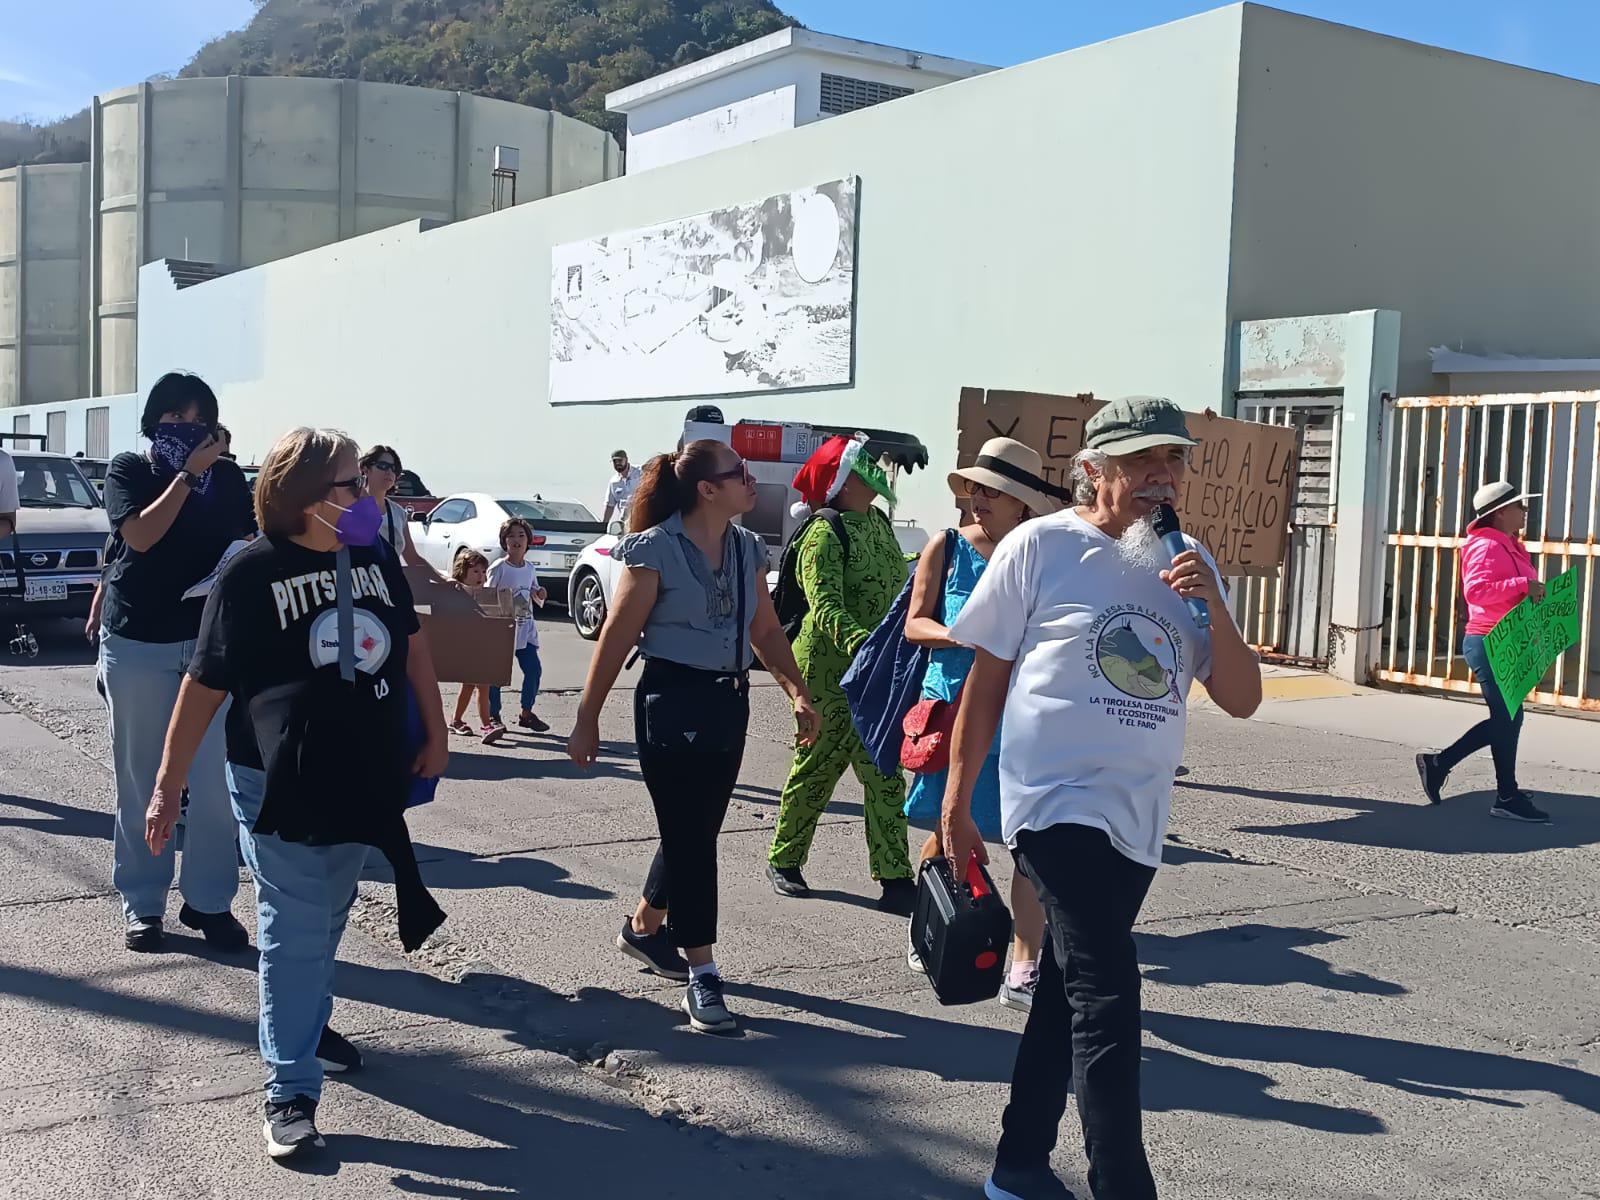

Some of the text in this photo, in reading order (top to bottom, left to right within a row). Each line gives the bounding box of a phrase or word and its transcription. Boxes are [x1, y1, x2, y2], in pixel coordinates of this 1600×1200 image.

[1238, 442, 1253, 485] A
[1265, 441, 1293, 488] LA
[1201, 482, 1278, 528] ESPACIO
[1146, 608, 1157, 620] LA
[1085, 638, 1095, 651] LA
[1087, 661, 1101, 679] NO
[1089, 696, 1100, 704] LA
[1102, 697, 1142, 709] TIROLESA
[1106, 707, 1166, 723] EL ECOSISTEMA
[1118, 717, 1157, 730] Y EL FARO
